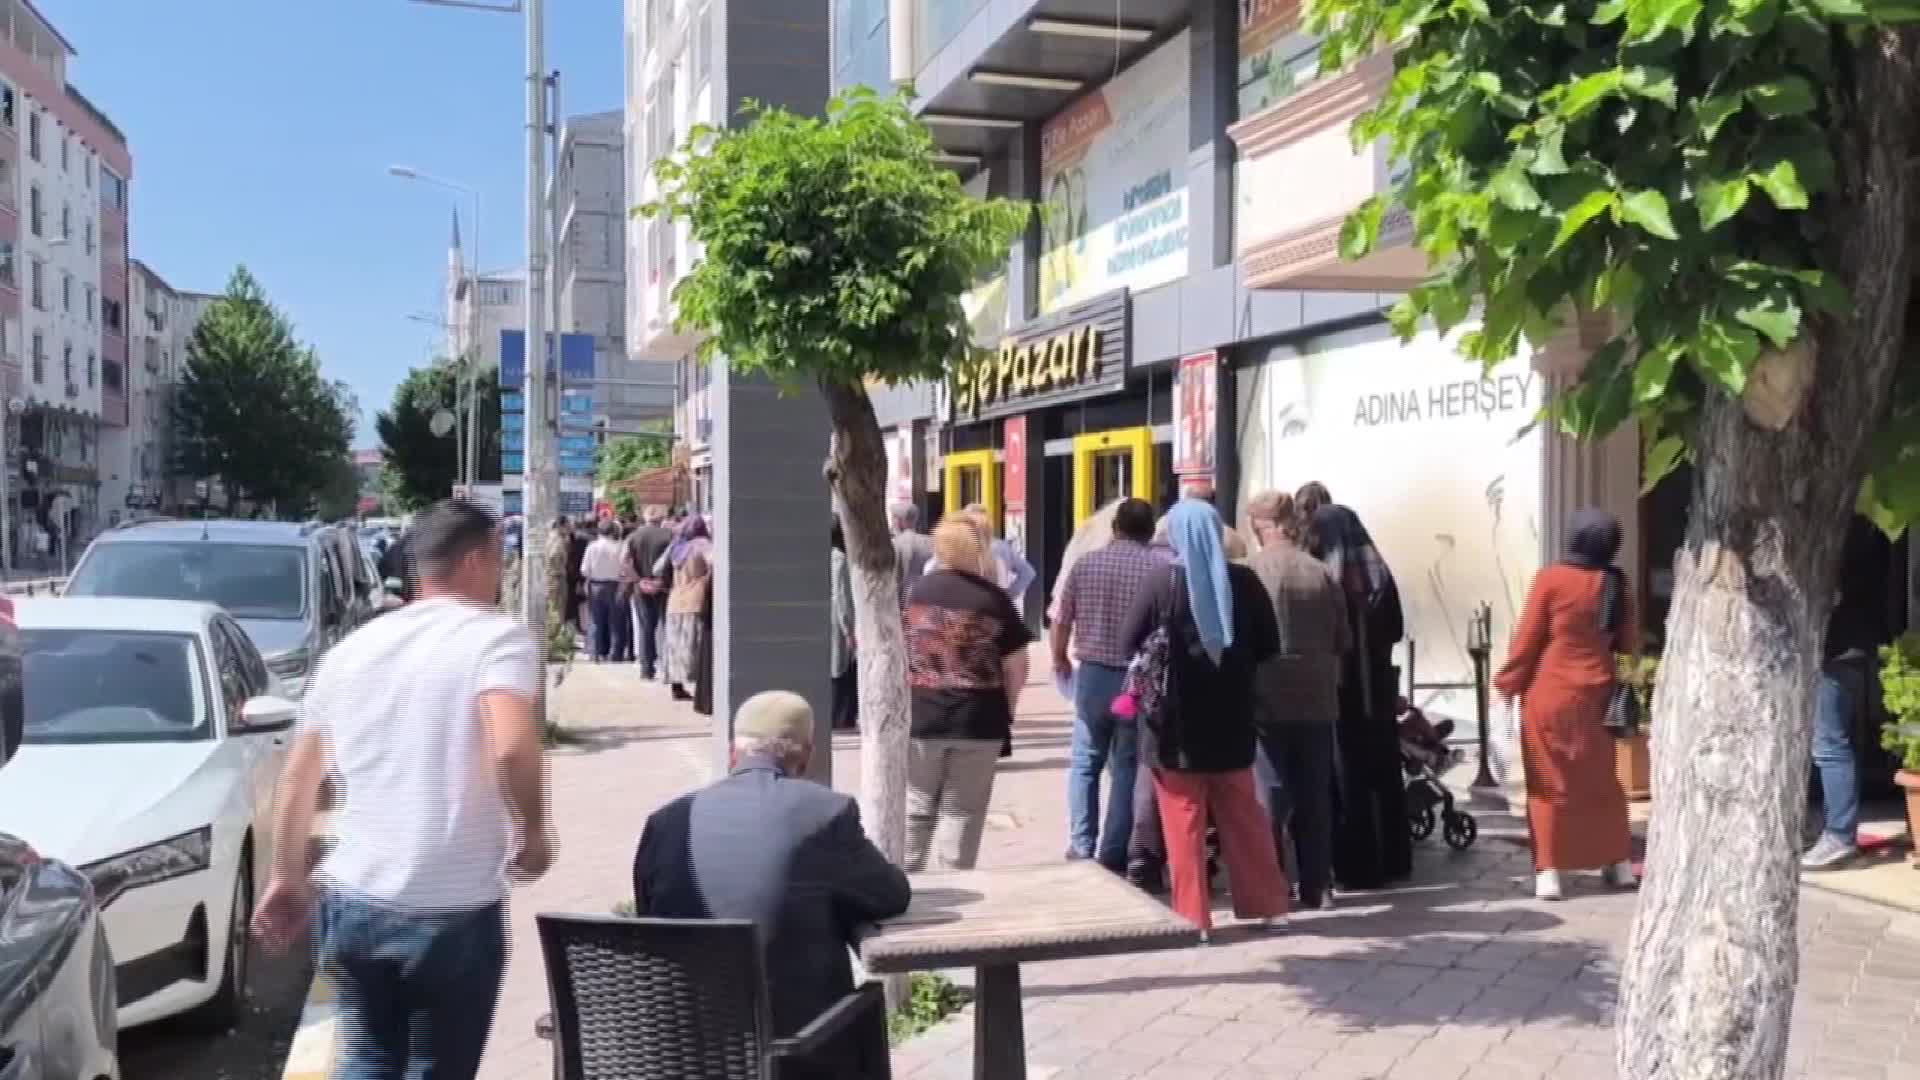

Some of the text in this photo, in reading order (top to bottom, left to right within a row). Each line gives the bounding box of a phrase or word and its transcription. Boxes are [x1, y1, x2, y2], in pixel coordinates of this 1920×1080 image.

[996, 327, 1097, 397] Pazarı
[1353, 372, 1535, 426] ADINA HERŞEY
